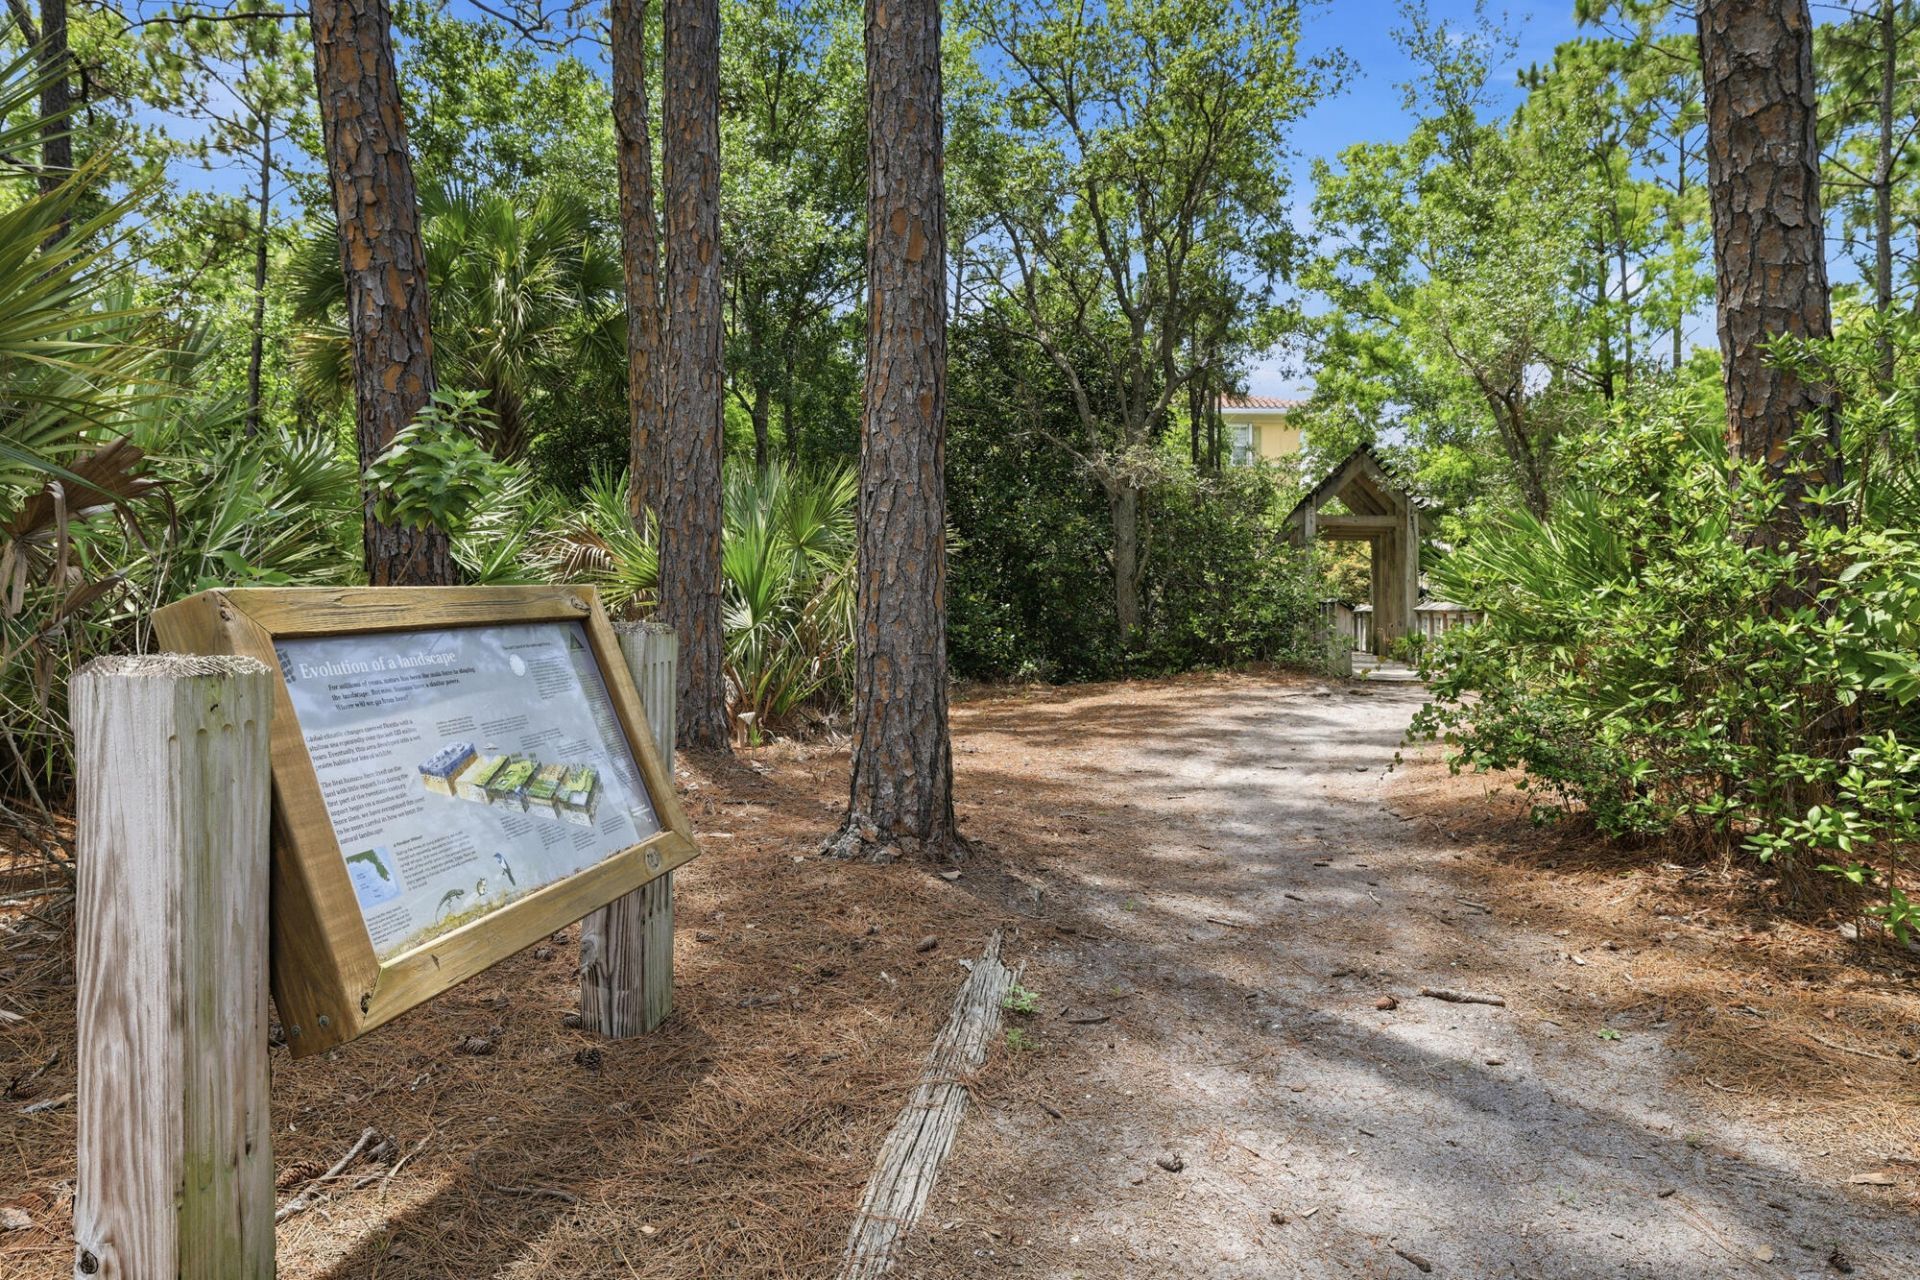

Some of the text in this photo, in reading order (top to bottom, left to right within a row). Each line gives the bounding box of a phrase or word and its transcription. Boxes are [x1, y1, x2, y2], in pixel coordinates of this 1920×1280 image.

[299, 651, 456, 679] Evolution of a landscape
